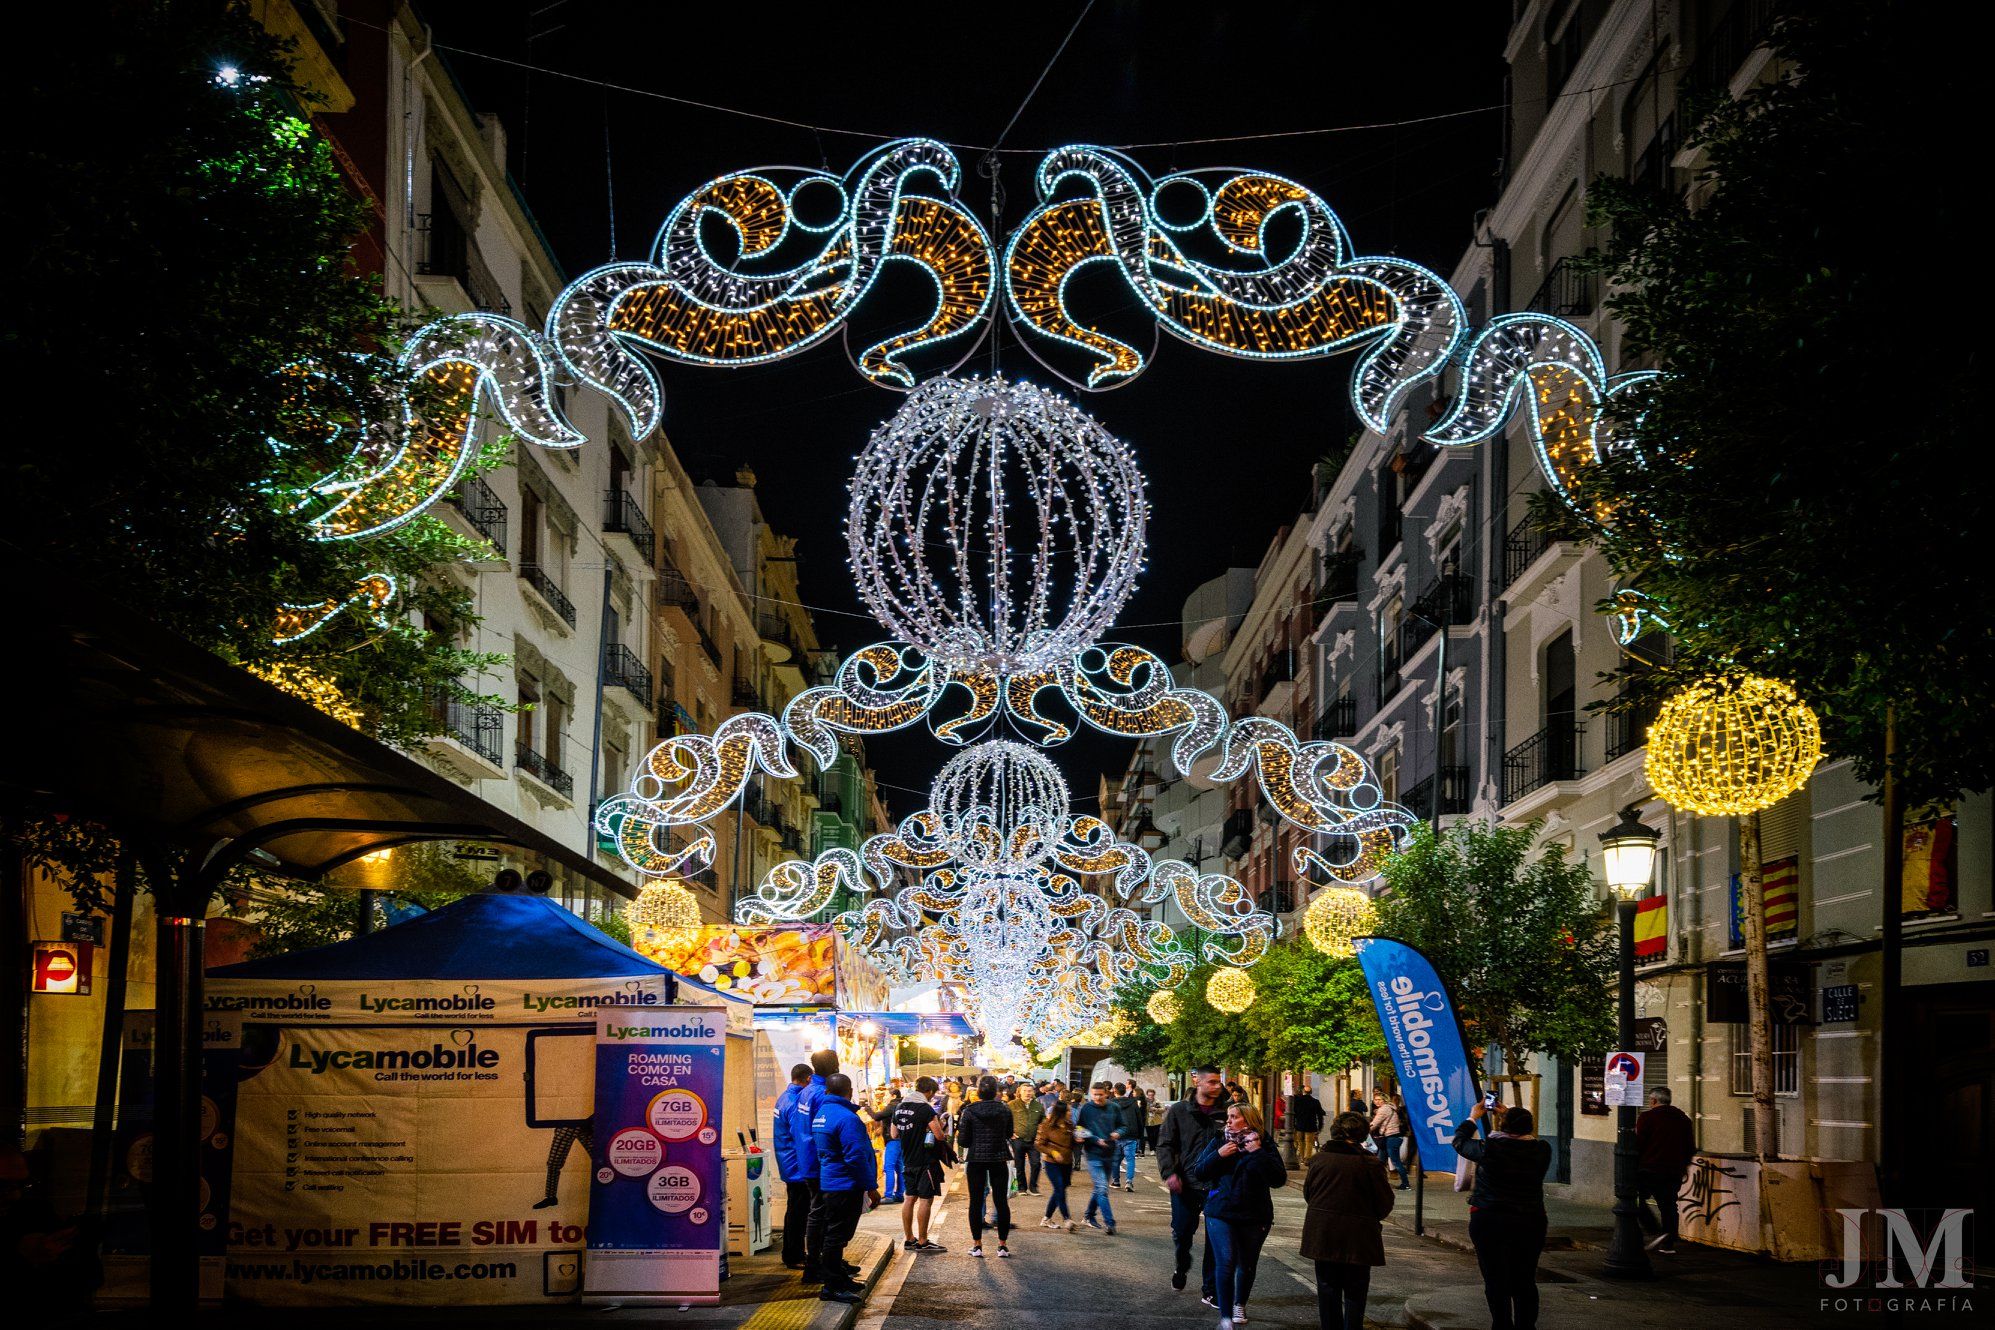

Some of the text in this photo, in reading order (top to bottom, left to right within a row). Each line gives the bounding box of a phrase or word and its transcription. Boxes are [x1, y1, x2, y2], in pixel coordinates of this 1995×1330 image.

[1828, 986, 1854, 999] CALLE
[360, 993, 496, 1012] Lycamobile
[524, 990, 657, 1012] Lycamobile
[606, 1024, 716, 1040] Lycamobile
[290, 1044, 500, 1074] Lycamobile
[628, 1054, 692, 1064] ROAMING
[628, 1065, 692, 1075] COMO EN
[375, 1072, 498, 1081] Call the world for less
[641, 1076, 678, 1086] CASA
[661, 1102, 692, 1112] 7GB
[616, 1140, 656, 1151] 20GB
[658, 1176, 690, 1187] 3GB
[226, 1222, 276, 1247] Get
[285, 1227, 359, 1252] your
[368, 1222, 462, 1246] FREE
[471, 1220, 537, 1246] SIM
